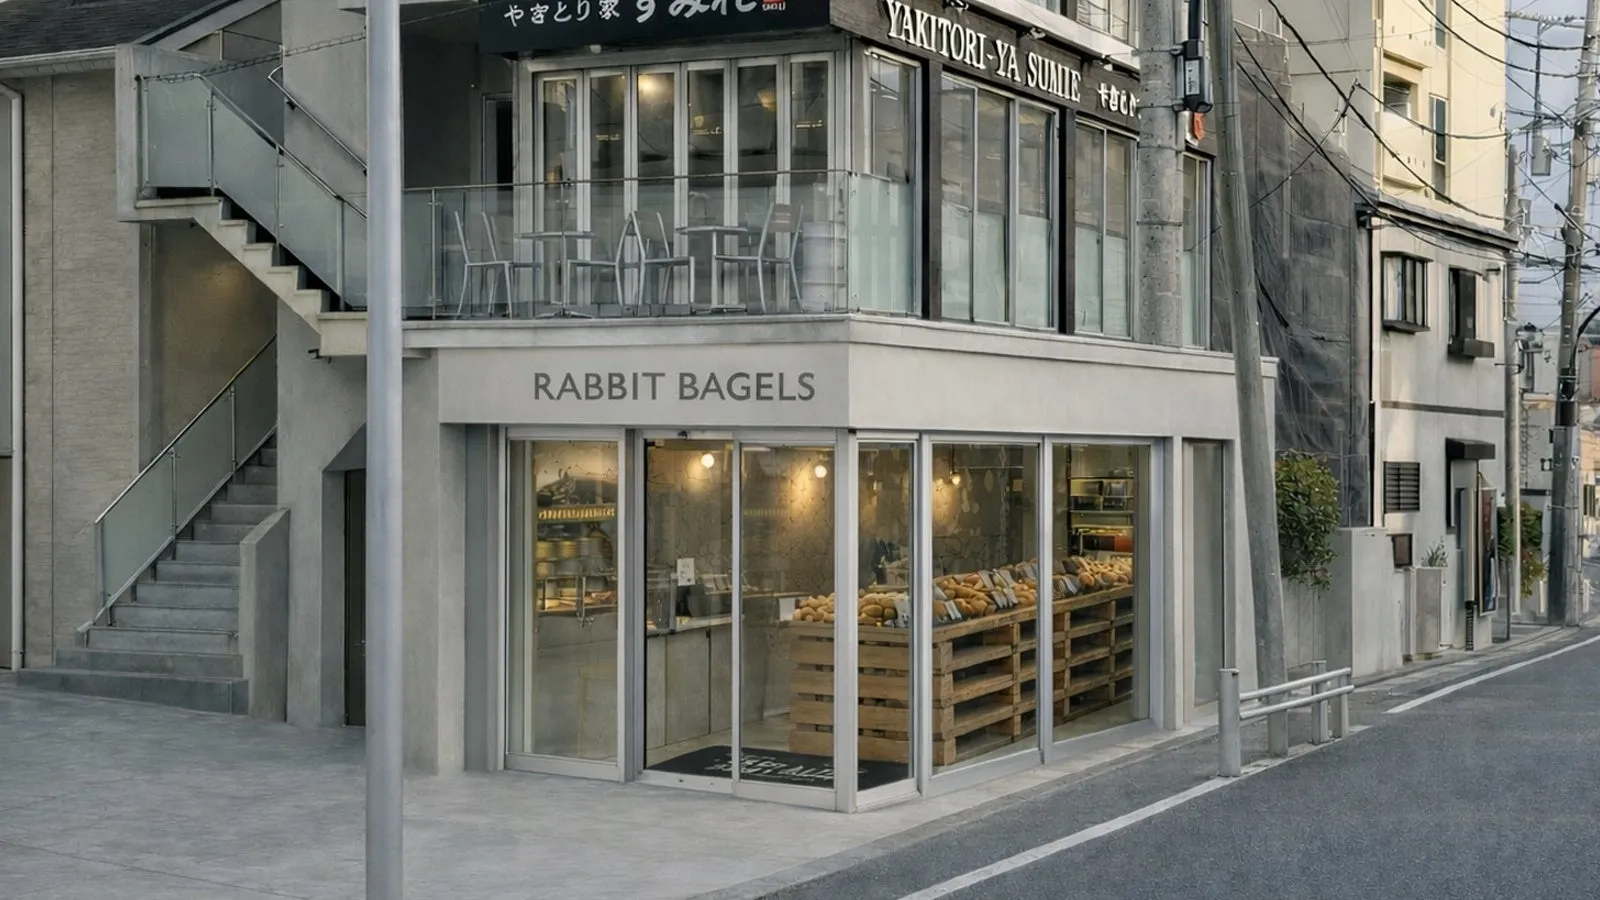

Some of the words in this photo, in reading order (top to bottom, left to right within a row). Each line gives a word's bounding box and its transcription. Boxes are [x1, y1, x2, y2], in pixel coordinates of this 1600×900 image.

[886, 0, 1021, 82] YAKITORI-YA
[534, 372, 666, 400] RABBIT
[679, 372, 816, 401] BAGELS
